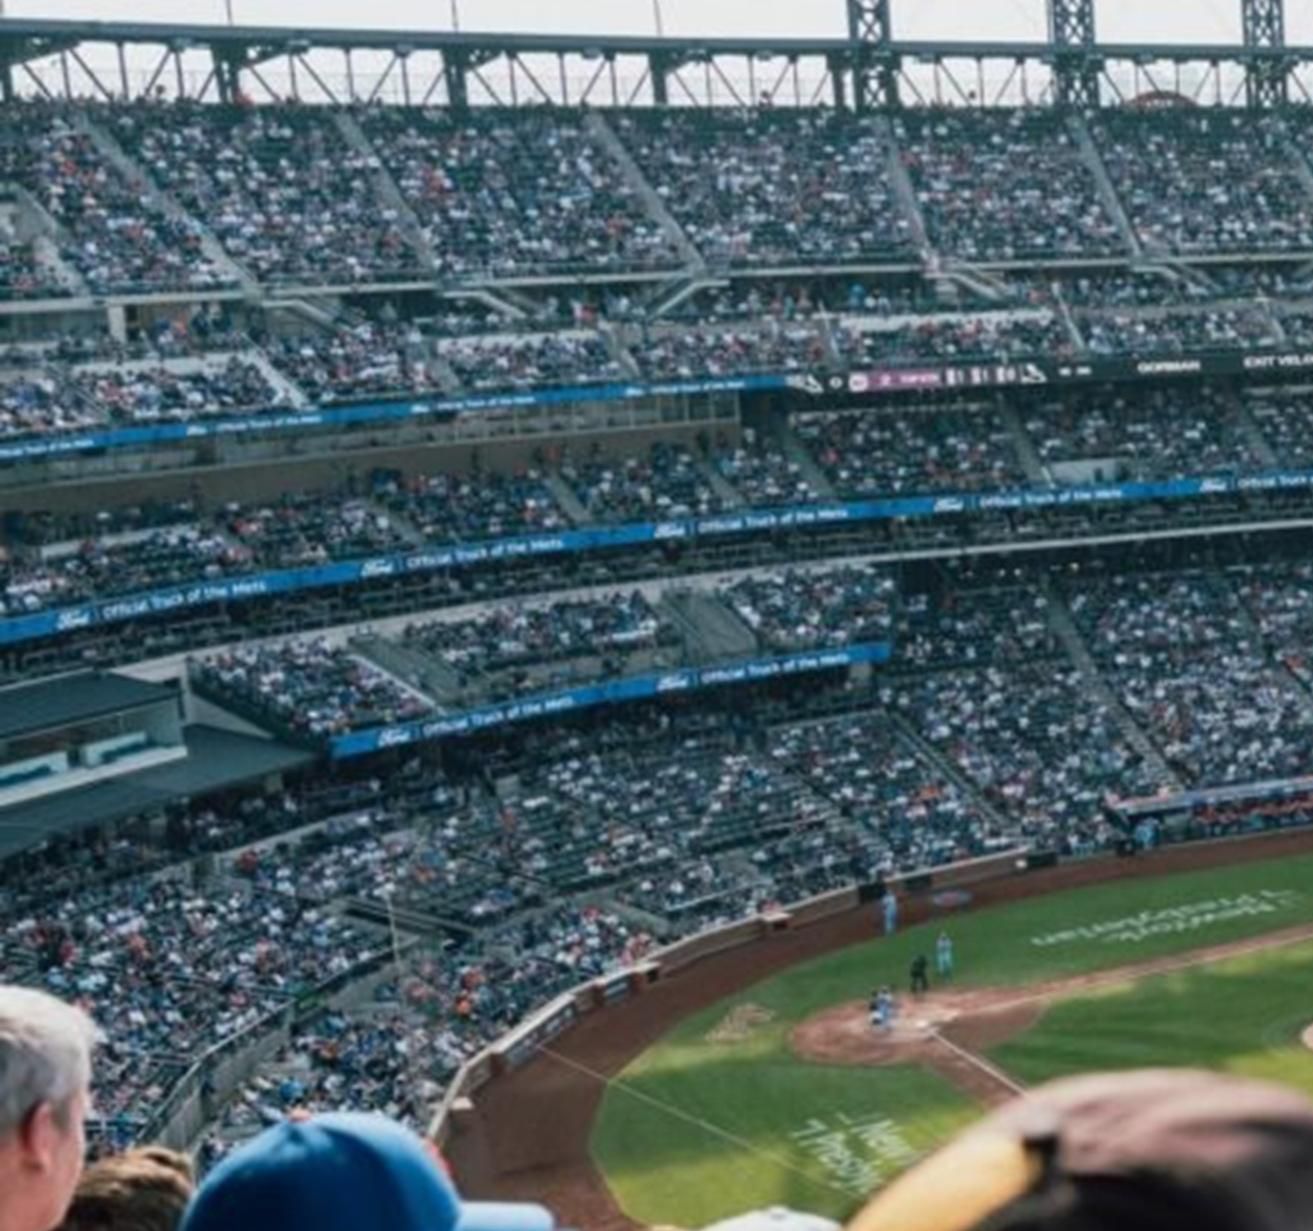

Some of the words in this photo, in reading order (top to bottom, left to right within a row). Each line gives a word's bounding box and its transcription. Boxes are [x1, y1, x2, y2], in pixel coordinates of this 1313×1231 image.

[1137, 360, 1200, 374] GORMAN
[1243, 355, 1276, 368] EXIT
[407, 551, 452, 570] Official
[456, 546, 487, 562] Truck
[530, 537, 563, 551] Mets
[102, 600, 149, 620] Official
[152, 592, 184, 609] Truck
[231, 579, 267, 596] Mets
